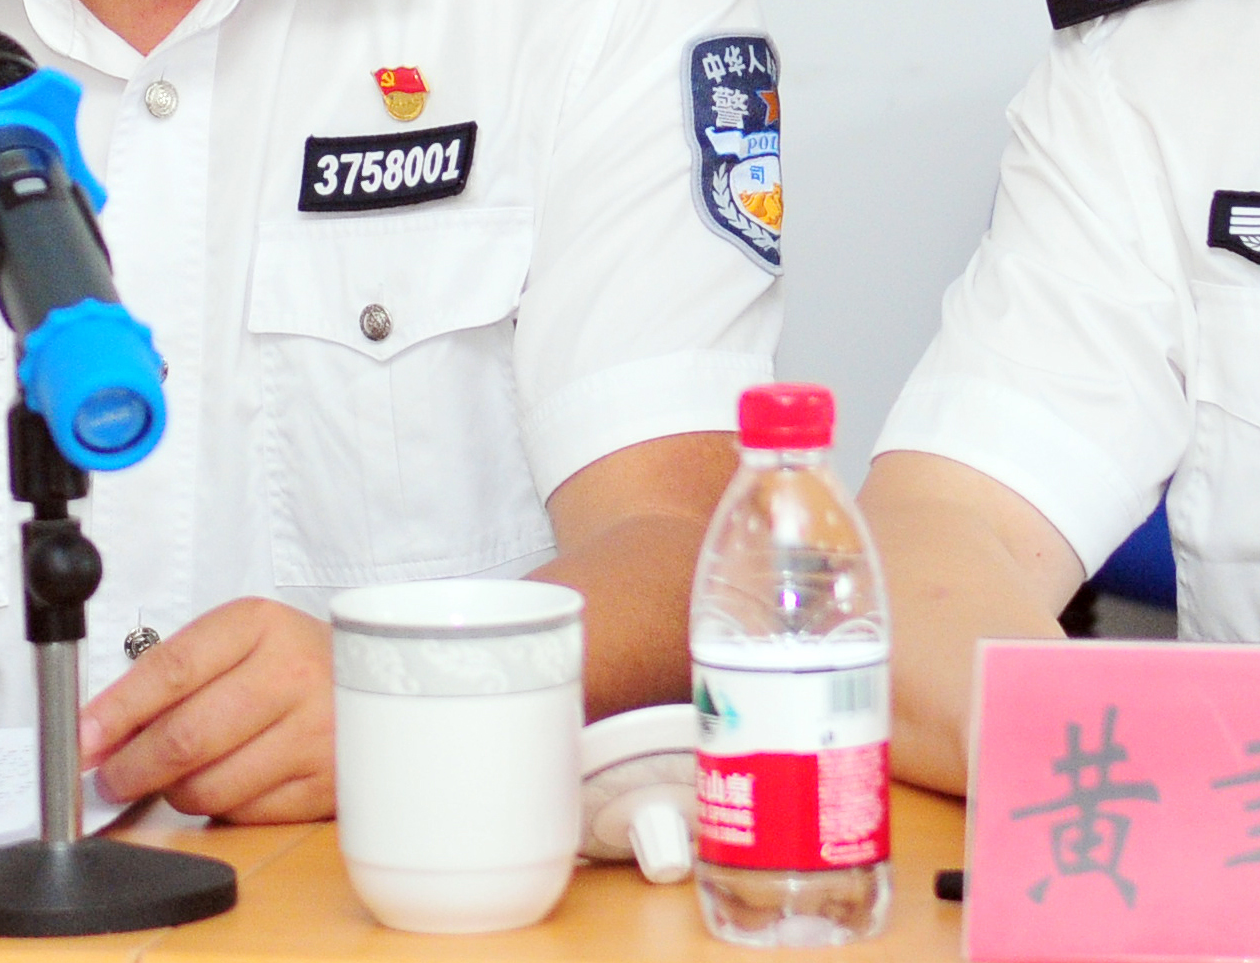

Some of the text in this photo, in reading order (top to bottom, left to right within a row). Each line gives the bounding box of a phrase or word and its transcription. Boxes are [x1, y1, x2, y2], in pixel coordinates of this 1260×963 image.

[712, 86, 749, 129] 警
[314, 139, 461, 195] 3758001
[750, 166, 764, 184] 司
